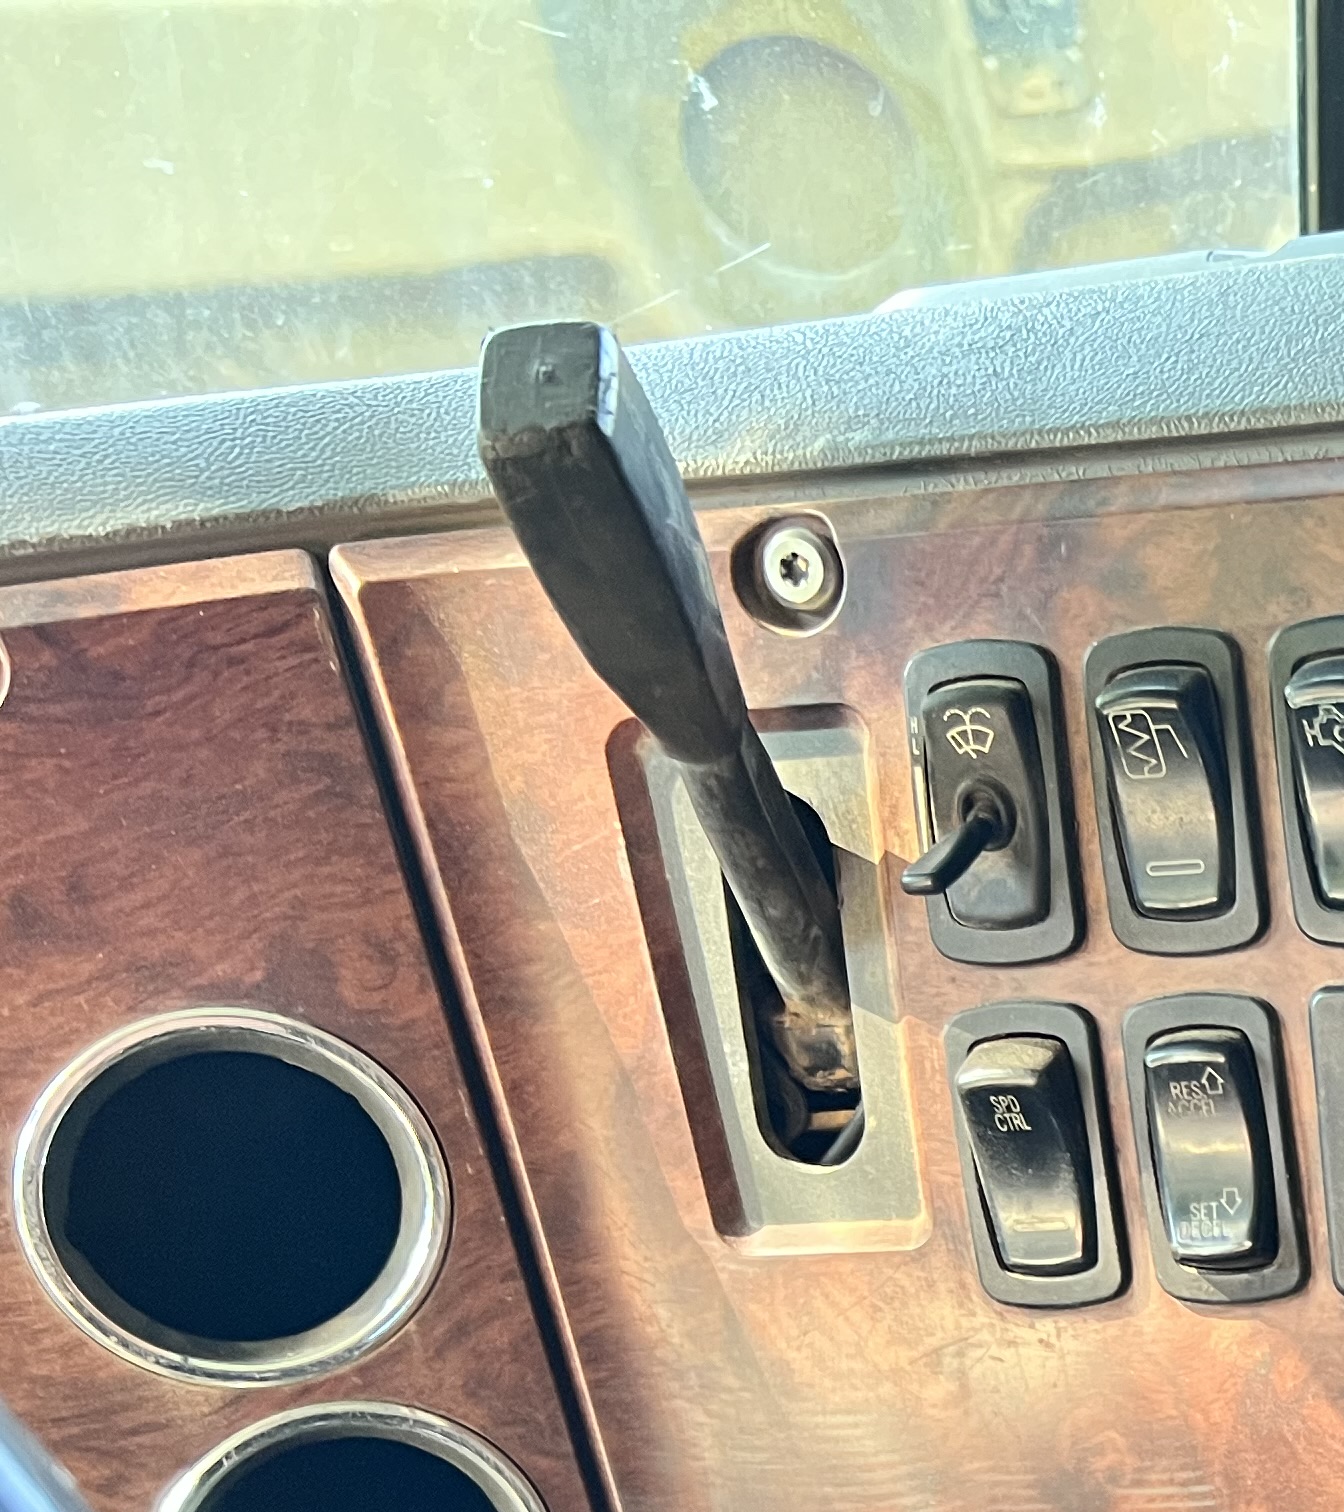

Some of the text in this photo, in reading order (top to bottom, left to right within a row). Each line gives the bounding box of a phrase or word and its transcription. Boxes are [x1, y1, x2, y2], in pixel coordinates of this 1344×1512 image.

[989, 1095, 1021, 1113] SPD
[994, 1113, 1032, 1132] CTRL
[1189, 1201, 1219, 1220] SET
[1179, 1219, 1231, 1239] DECEL
